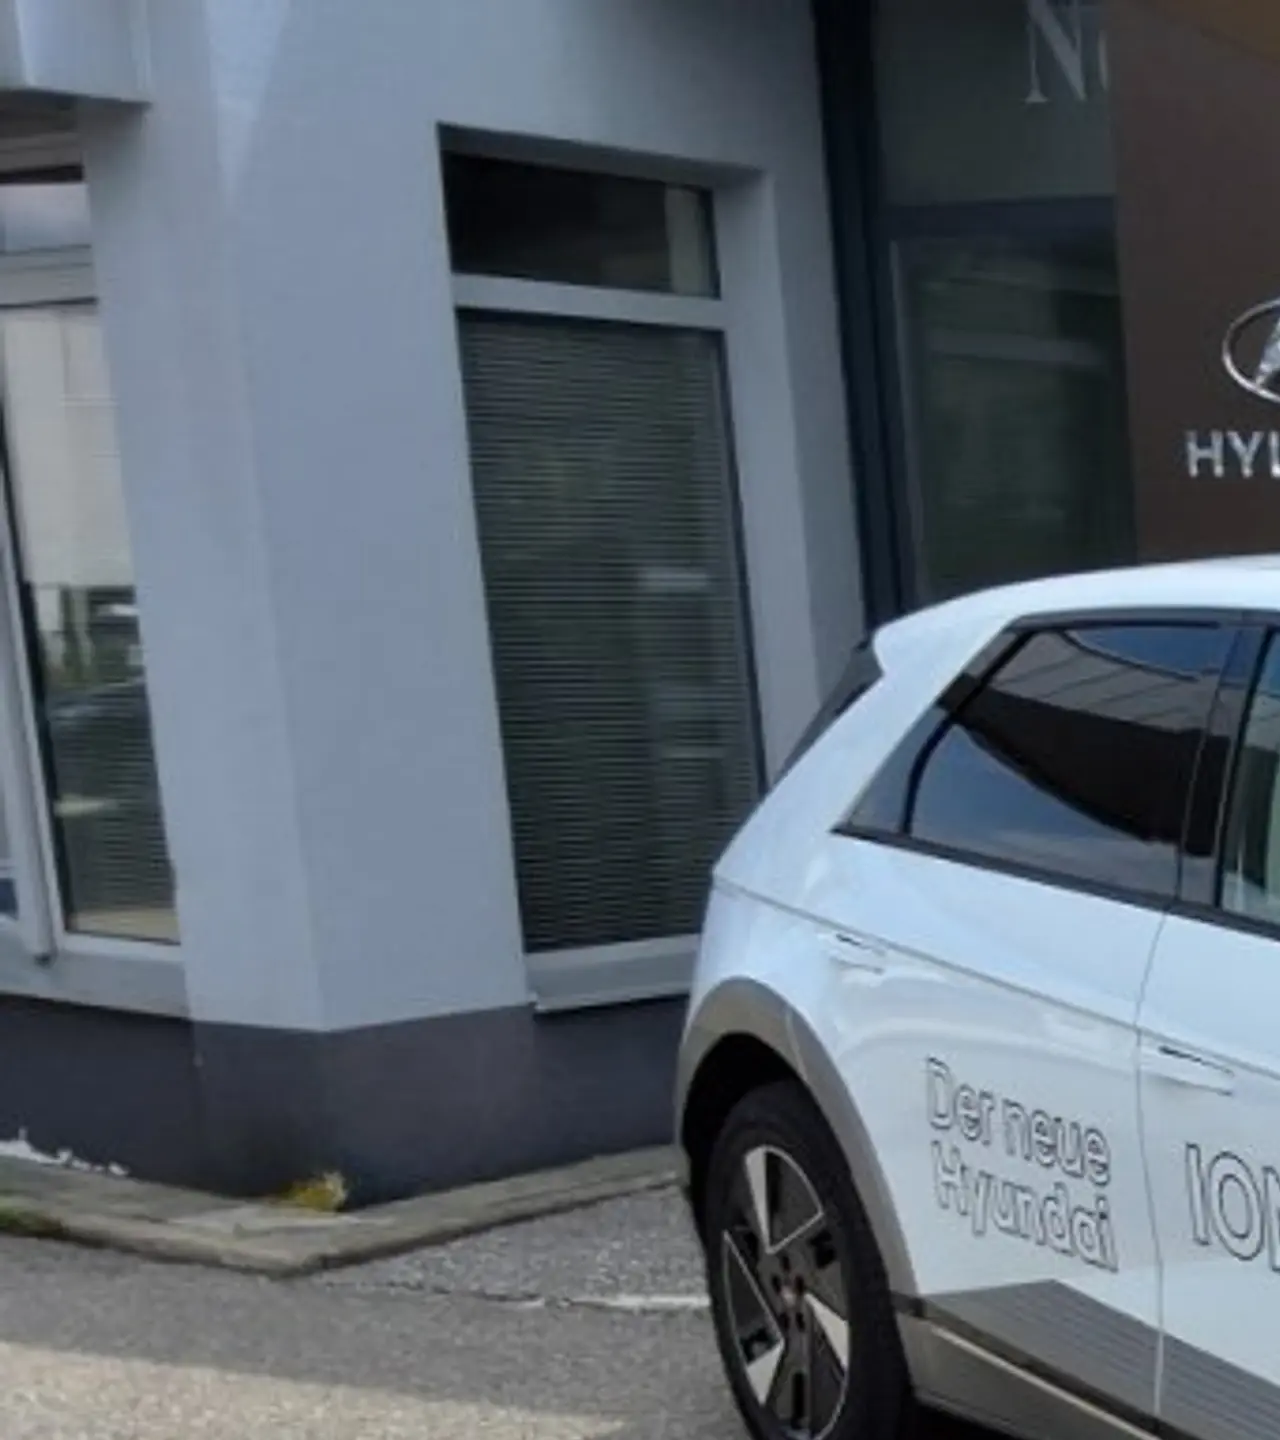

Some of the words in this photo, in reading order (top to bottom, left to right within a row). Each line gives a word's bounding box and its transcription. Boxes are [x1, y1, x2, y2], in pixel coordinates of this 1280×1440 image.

[926, 1057, 994, 1146] Der
[1001, 1097, 1111, 1186] neue
[932, 1140, 1117, 1273] Hyundai
